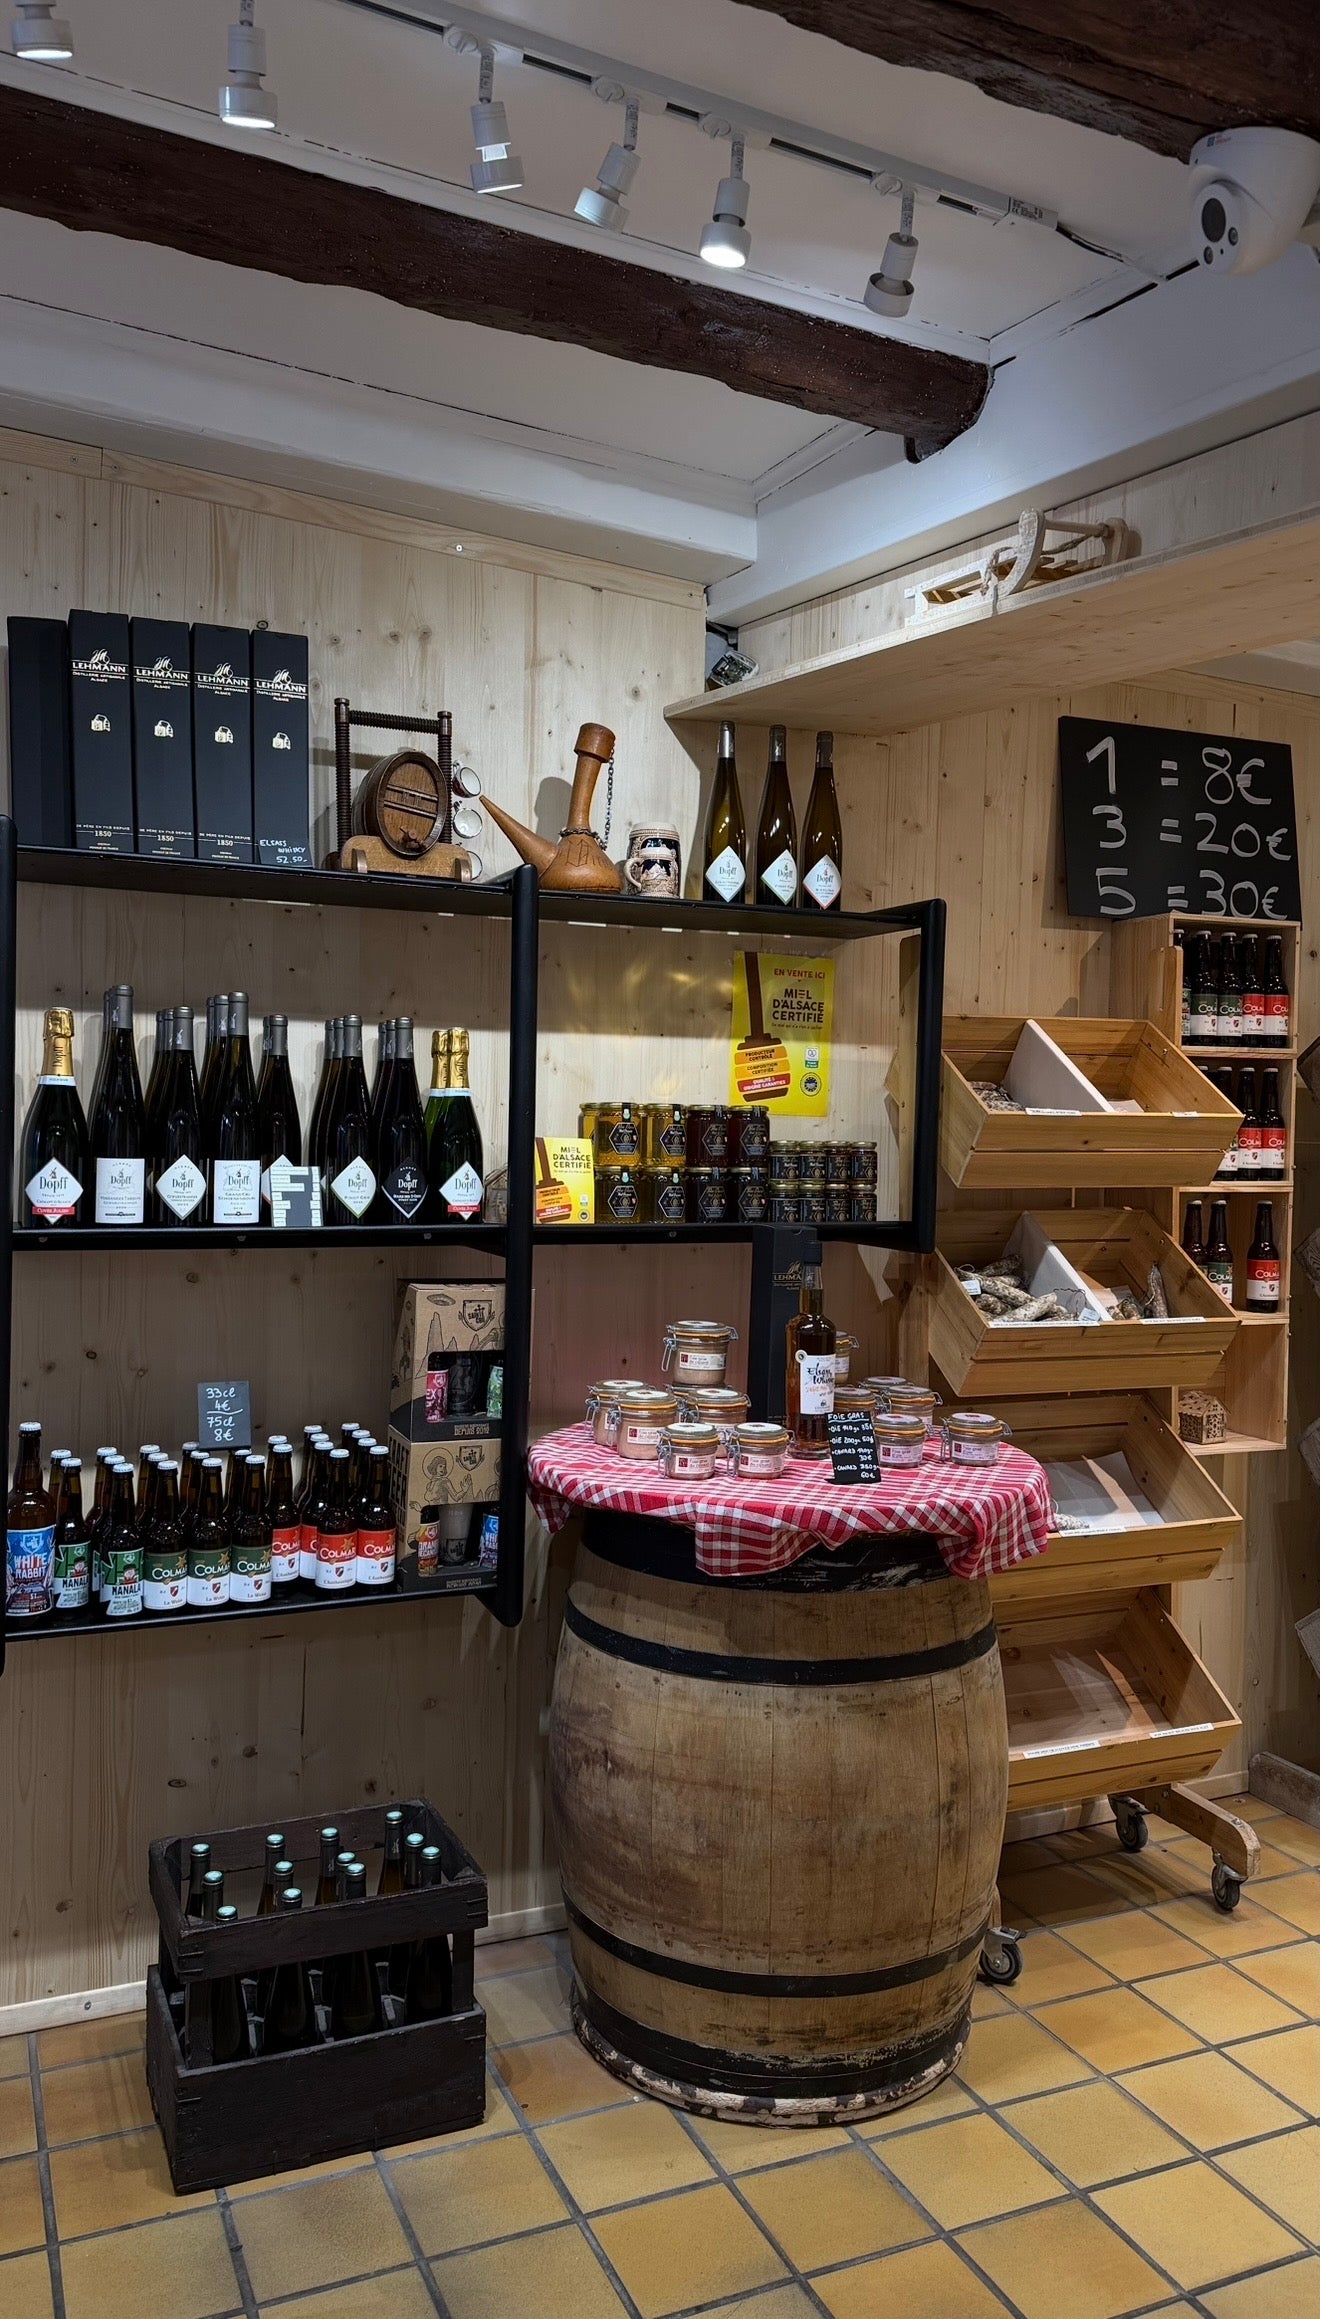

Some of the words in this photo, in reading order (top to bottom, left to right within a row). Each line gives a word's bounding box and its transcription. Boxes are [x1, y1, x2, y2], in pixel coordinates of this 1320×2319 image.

[72, 661, 126, 673] LEHMANN
[136, 668, 189, 680] LEHMANN
[197, 675, 249, 687] LEHMANN
[256, 681, 307, 693] LEHMANN
[1086, 736, 1116, 794] 1
[1202, 747, 1272, 805] 8€
[94, 830, 112, 838] 1850
[157, 835, 175, 843] 1850
[1092, 805, 1127, 849] 3
[1195, 812, 1292, 861] 20€
[259, 839, 287, 848] ELSASS
[719, 866, 737, 877] Dopff
[777, 868, 793, 879] Dopff
[816, 874, 834, 885] Dopff
[1096, 868, 1136, 915] 5
[1200, 870, 1288, 920] 30€
[774, 968, 785, 976] EN
[787, 969, 813, 978] VENTE
[815, 971, 826, 979] ICI
[784, 988, 812, 1000] MIEL
[772, 998, 825, 1011] D'ALSACE
[772, 1009, 824, 1024] CERTIFIÉ
[745, 1048, 775, 1057] PRODUCTEUR
[747, 1062, 778, 1071] COMPOSITION
[40, 1177, 68, 1193] Dopff
[111, 1175, 131, 1186] Dopff
[172, 1179, 194, 1191] Dopff
[228, 1175, 250, 1189] Dopff
[348, 1178, 368, 1190] Dopff
[398, 1179, 418, 1190] Dopff
[455, 1178, 476, 1193] Dopff
[206, 1387, 236, 1399] 33cl
[215, 1399, 231, 1411] 4€
[206, 1416, 235, 1428] 75cl
[847, 1412, 865, 1420] GRAS
[214, 1428, 234, 1442] 8€
[14, 1552, 48, 1569] WHITE
[15, 1565, 47, 1579] RABBIT
